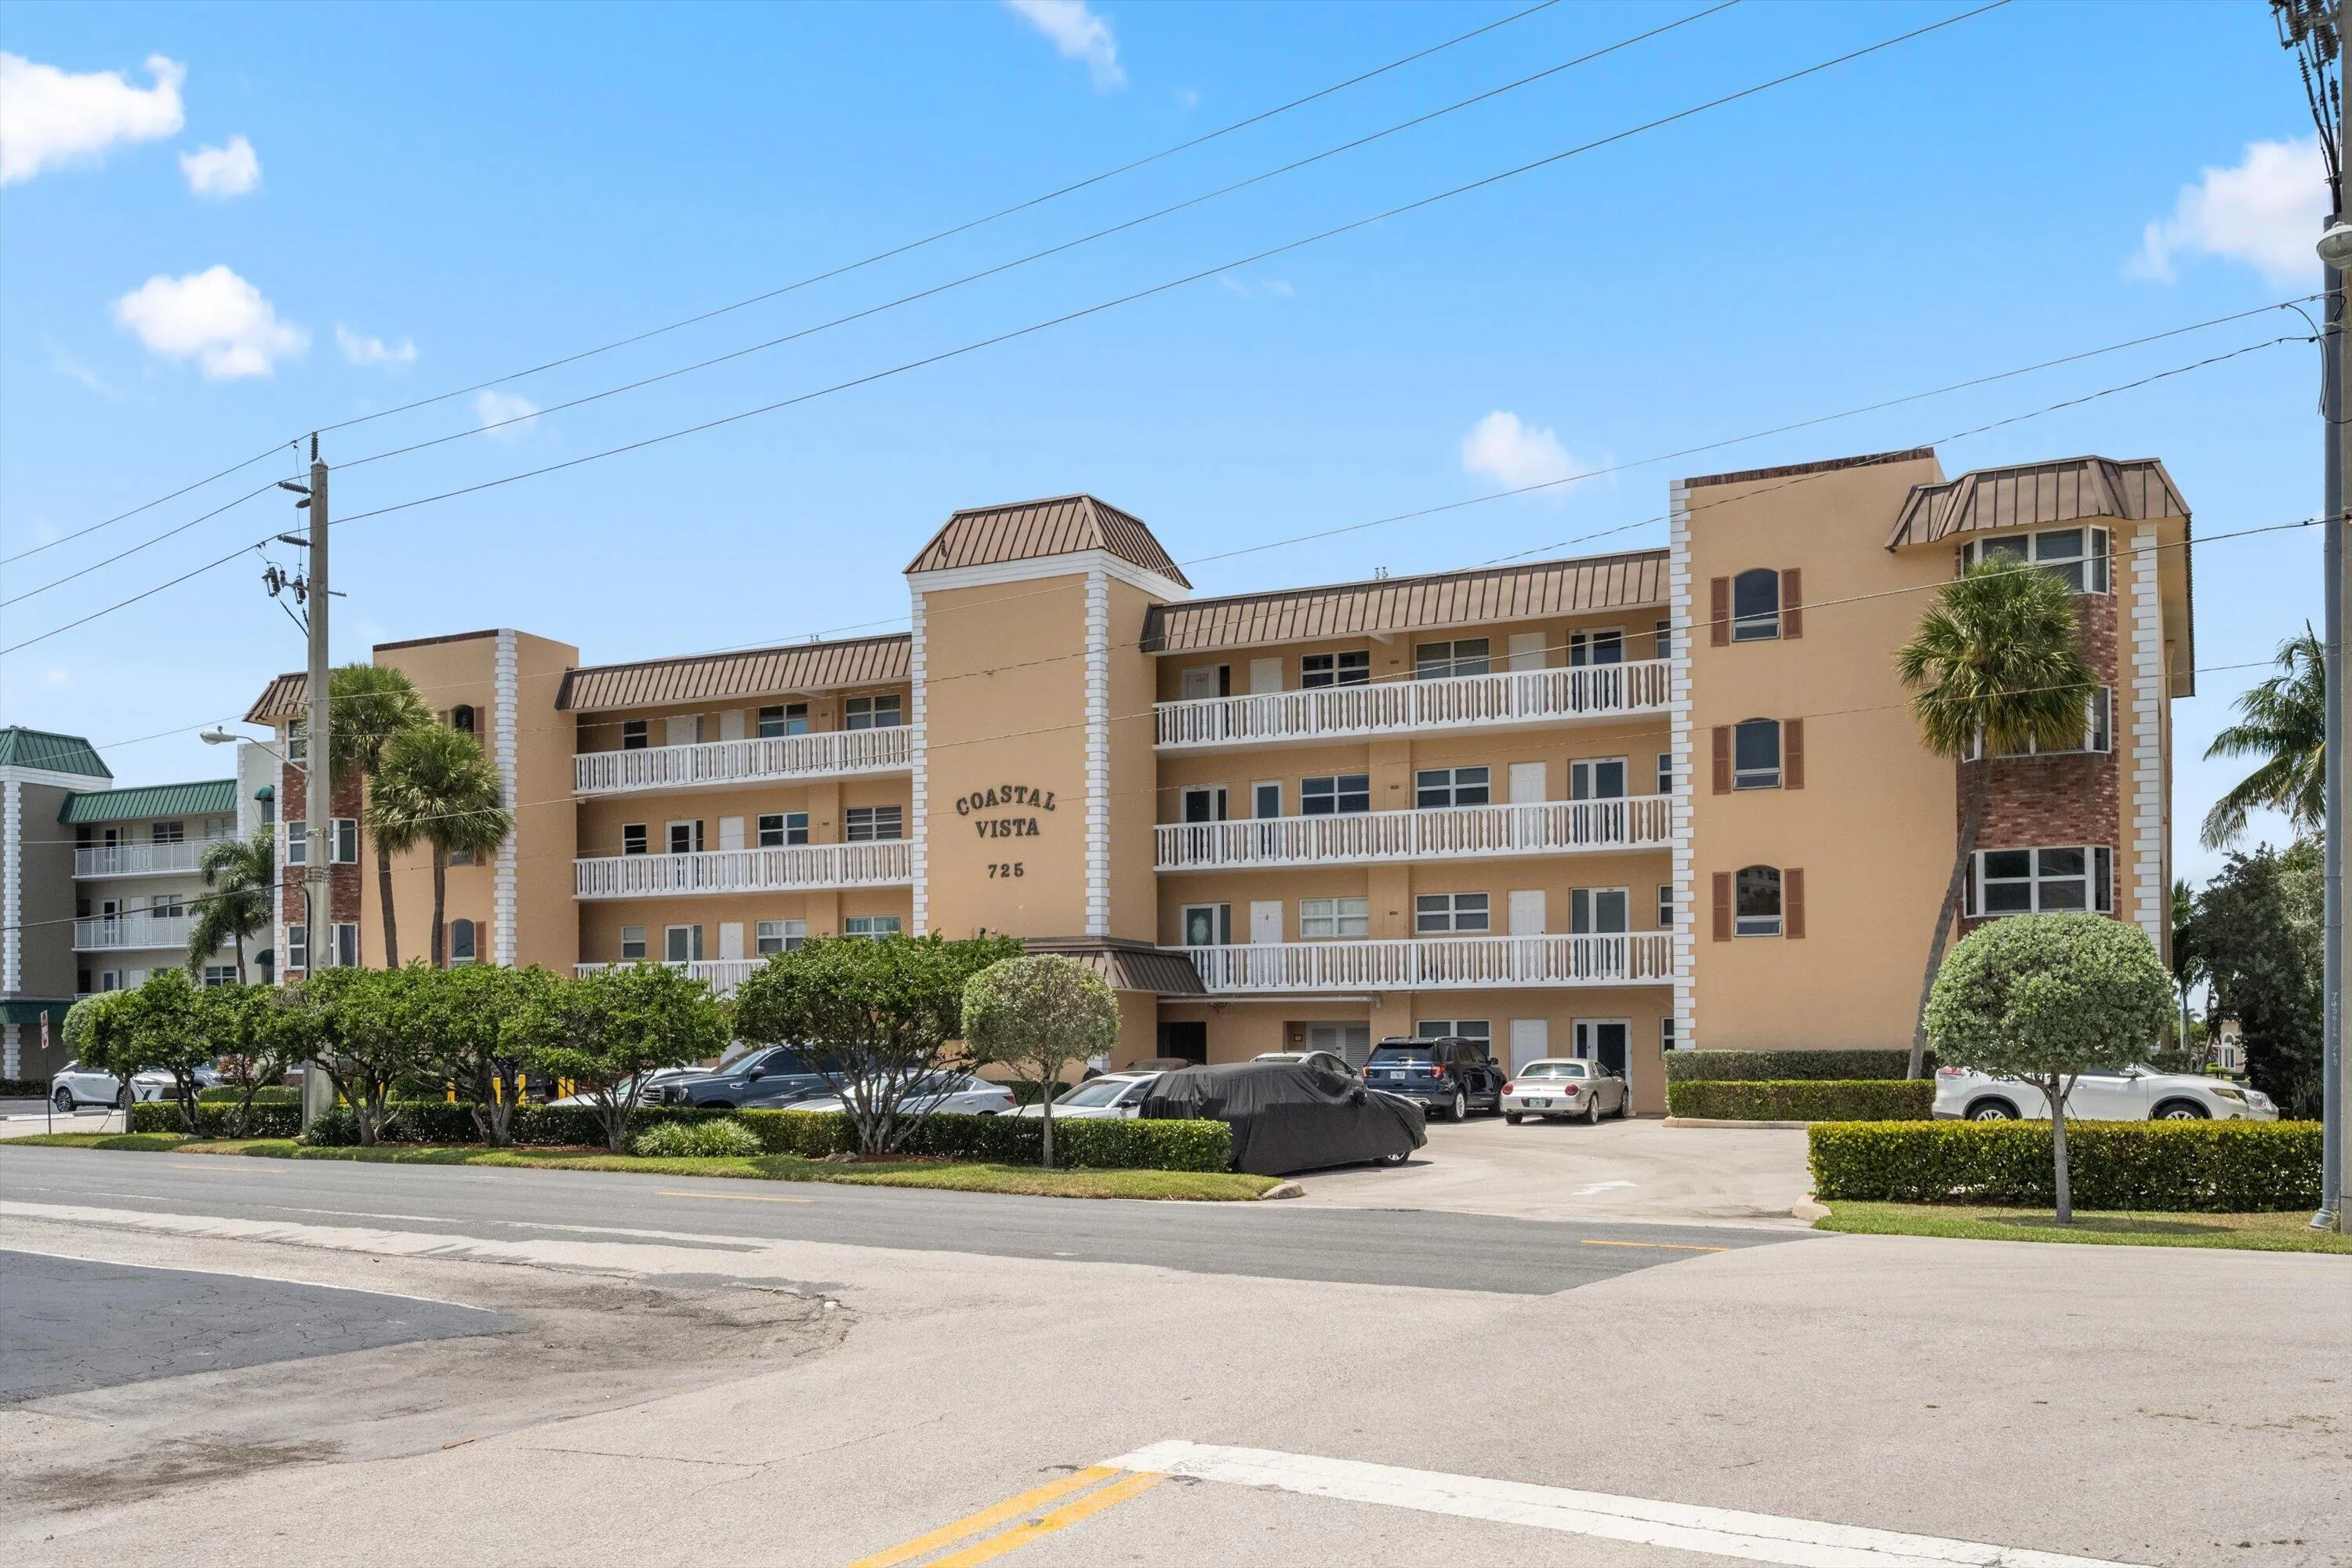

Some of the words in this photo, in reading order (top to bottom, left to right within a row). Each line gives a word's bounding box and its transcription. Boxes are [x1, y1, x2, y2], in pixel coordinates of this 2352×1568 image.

[956, 786, 1056, 815] COASTAL
[975, 818, 1040, 837] VISTA
[988, 862, 1024, 878] 725
